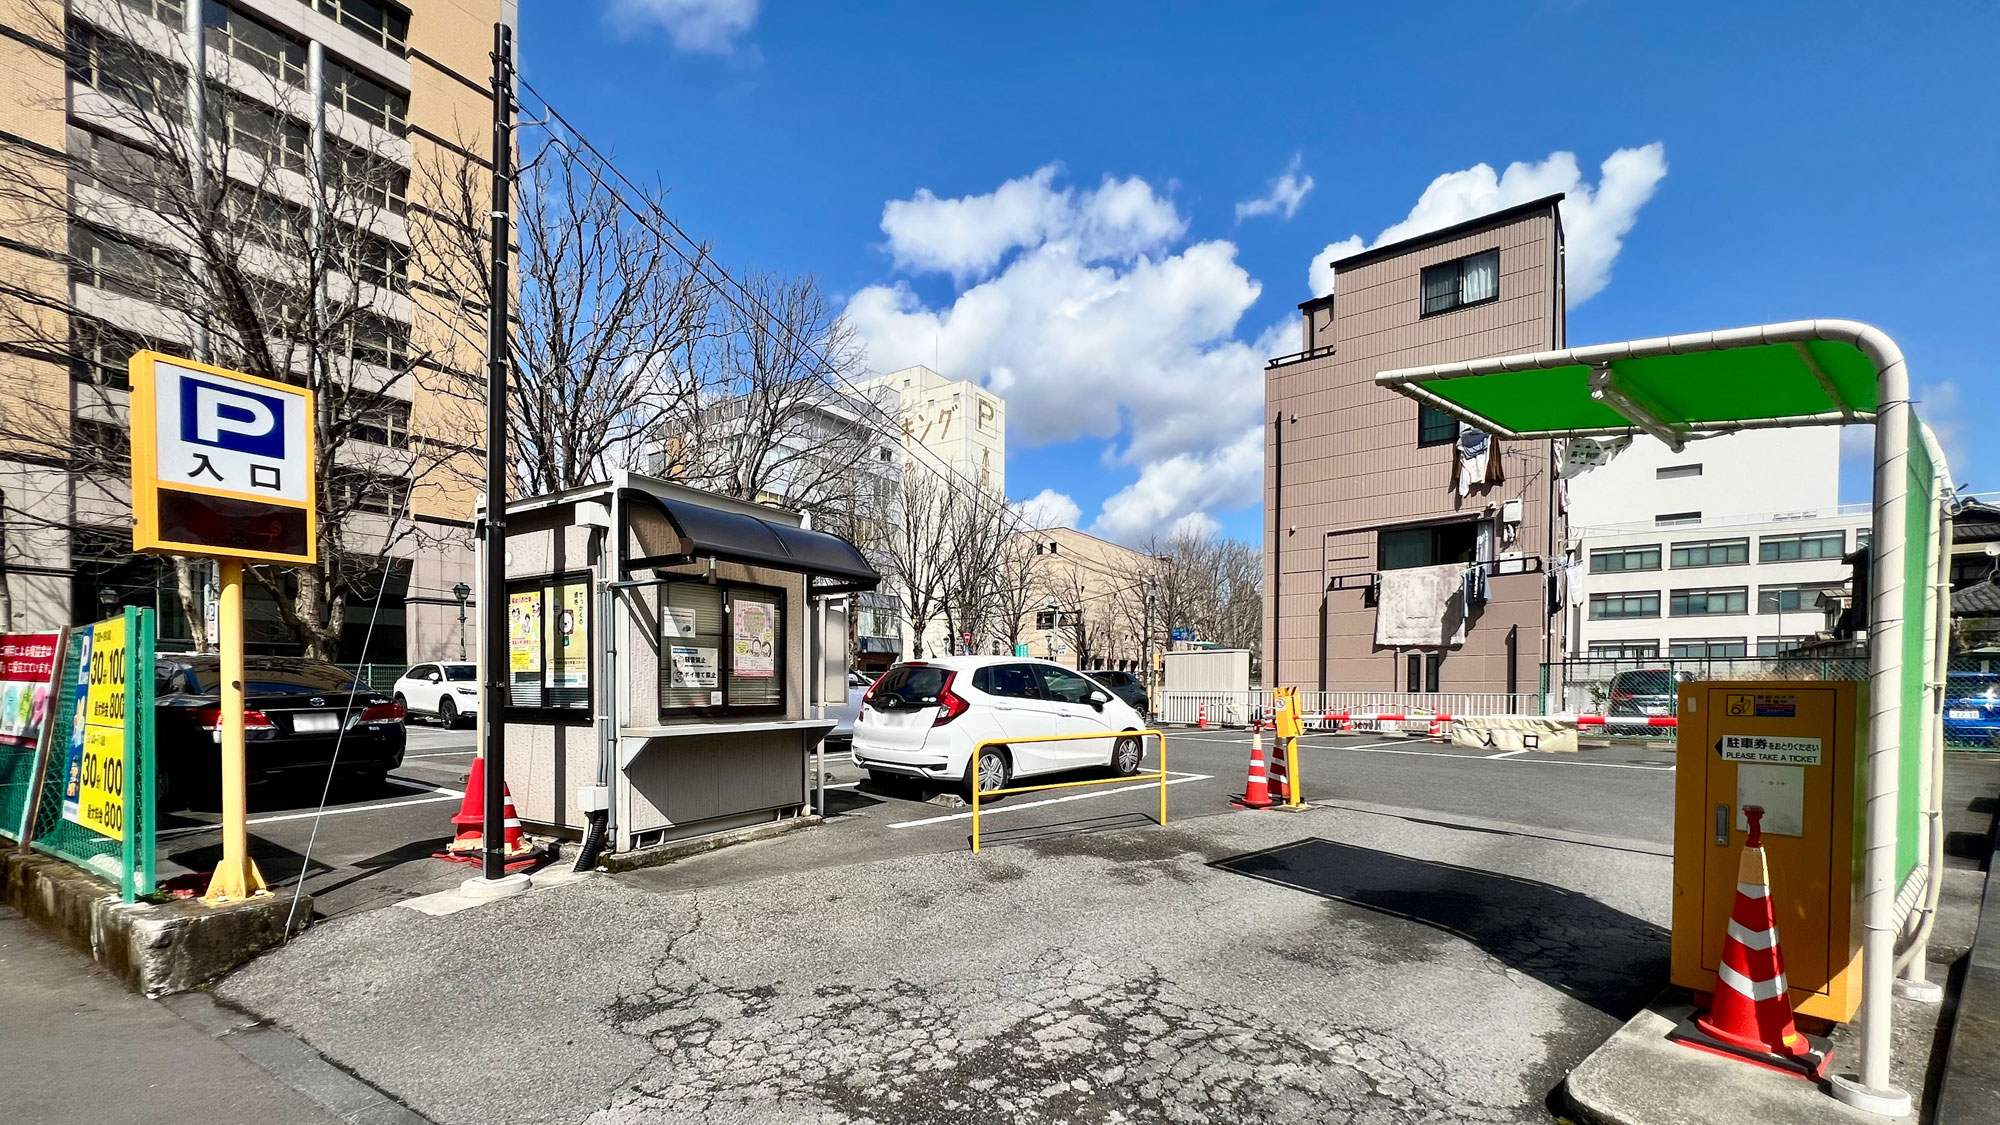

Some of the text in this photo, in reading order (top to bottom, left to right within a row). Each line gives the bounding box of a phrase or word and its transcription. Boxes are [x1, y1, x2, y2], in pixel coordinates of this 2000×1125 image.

[197, 386, 275, 443] P
[978, 398, 994, 429] P
[187, 453, 281, 491] 入口
[78, 635, 90, 685] P
[684, 671, 717, 679] ポイ捨て禁止
[1483, 732, 1539, 749] 入口
[1726, 736, 1819, 752] 駐車券をおとりください
[1726, 751, 1756, 760] PLEASE
[1758, 753, 1778, 761] TAKE
[1788, 755, 1818, 763] TICKET
[103, 757, 122, 797] 100
[104, 801, 122, 832] 800
